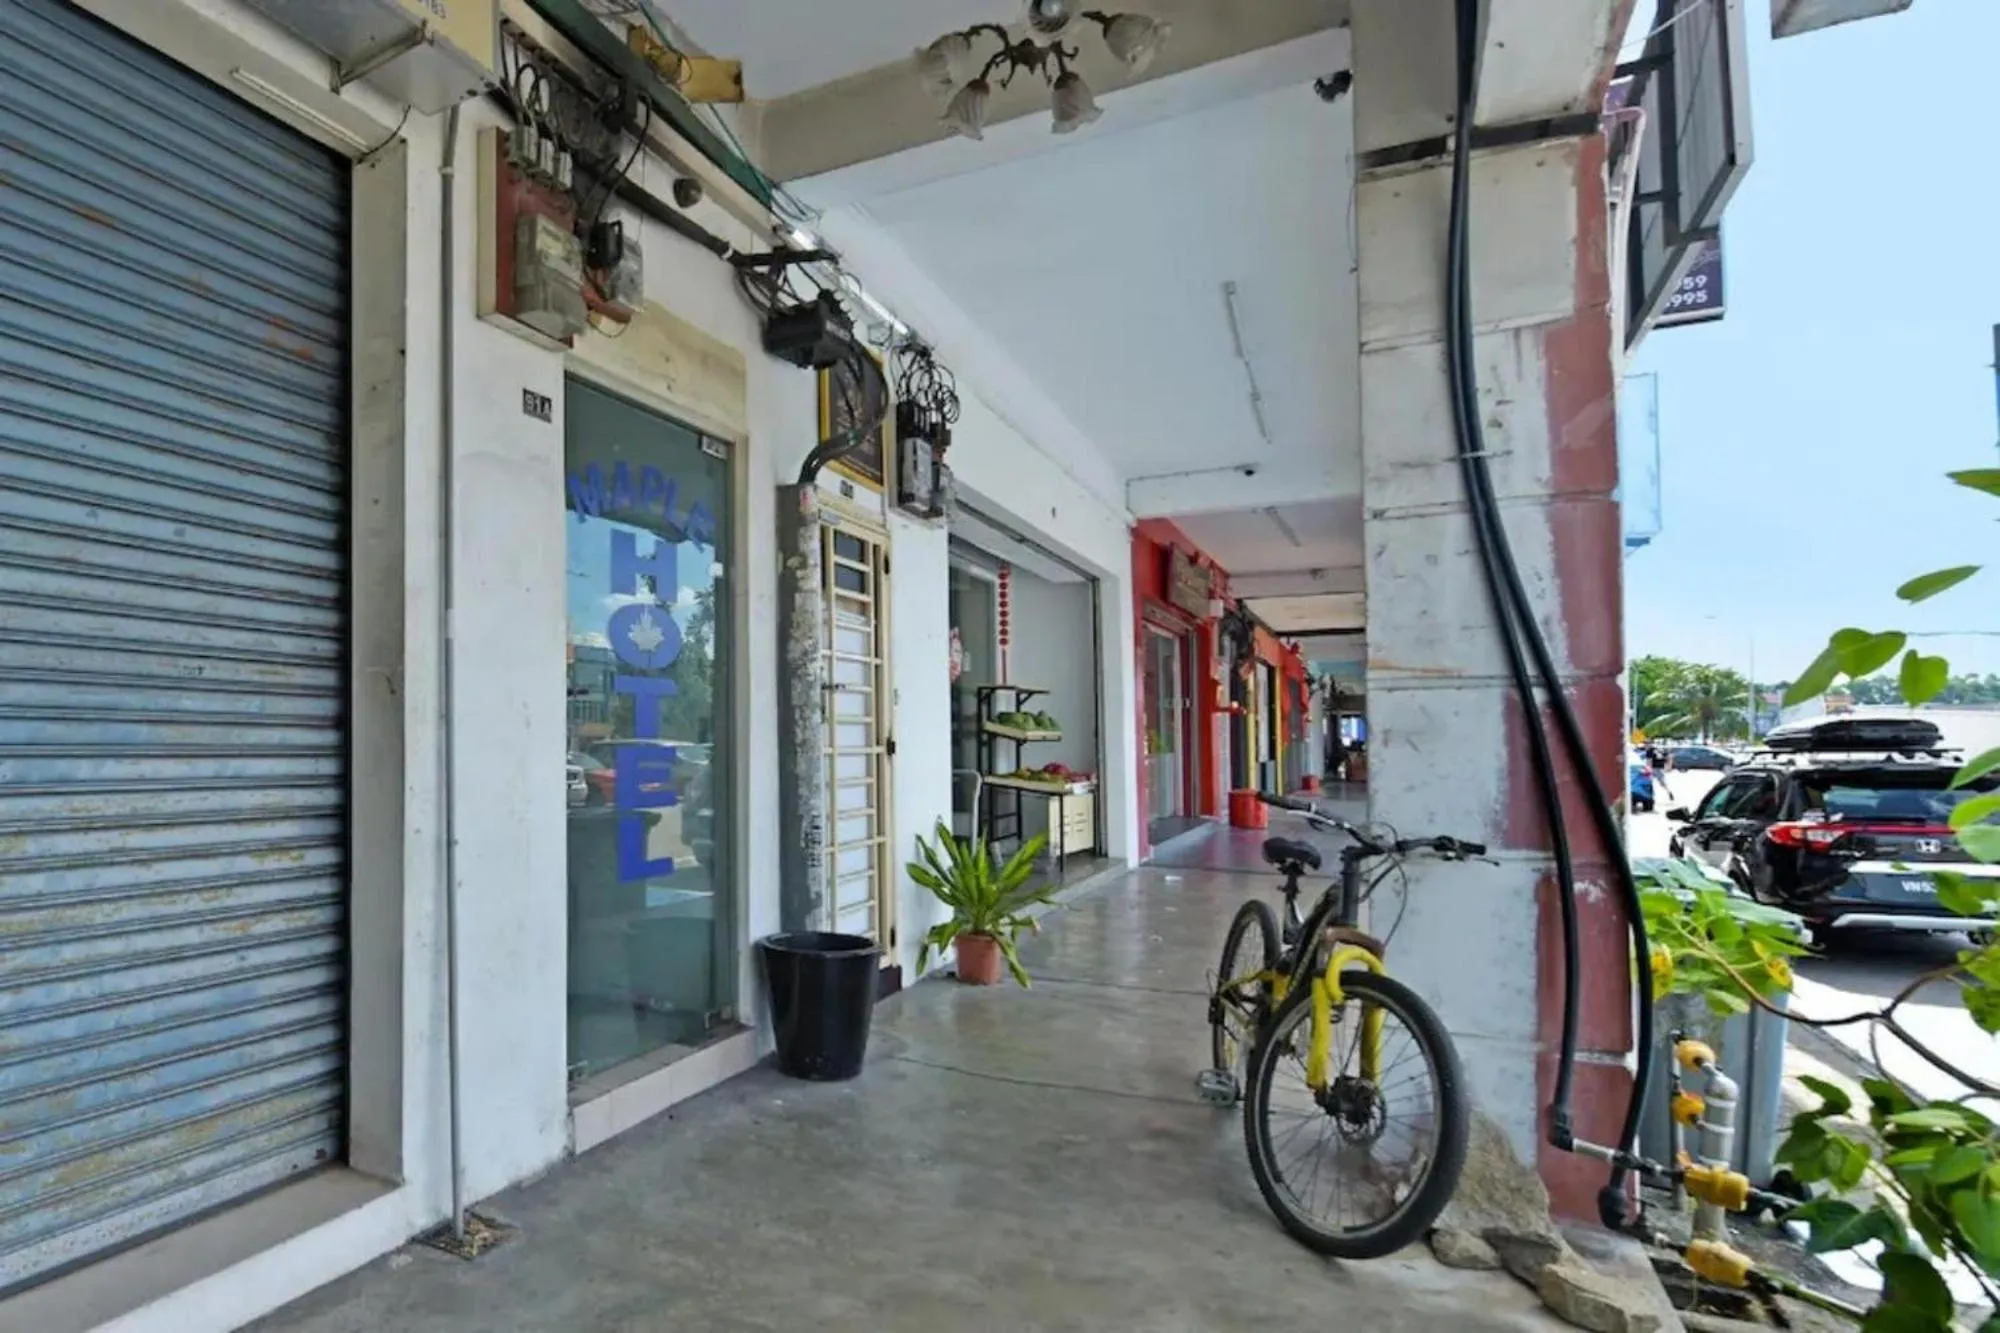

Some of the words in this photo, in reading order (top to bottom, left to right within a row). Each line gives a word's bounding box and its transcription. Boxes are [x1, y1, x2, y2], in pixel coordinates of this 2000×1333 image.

[1665, 289, 1709, 307] 995
[567, 459, 718, 553] MAPLE
[607, 528, 683, 884] HOTEL
